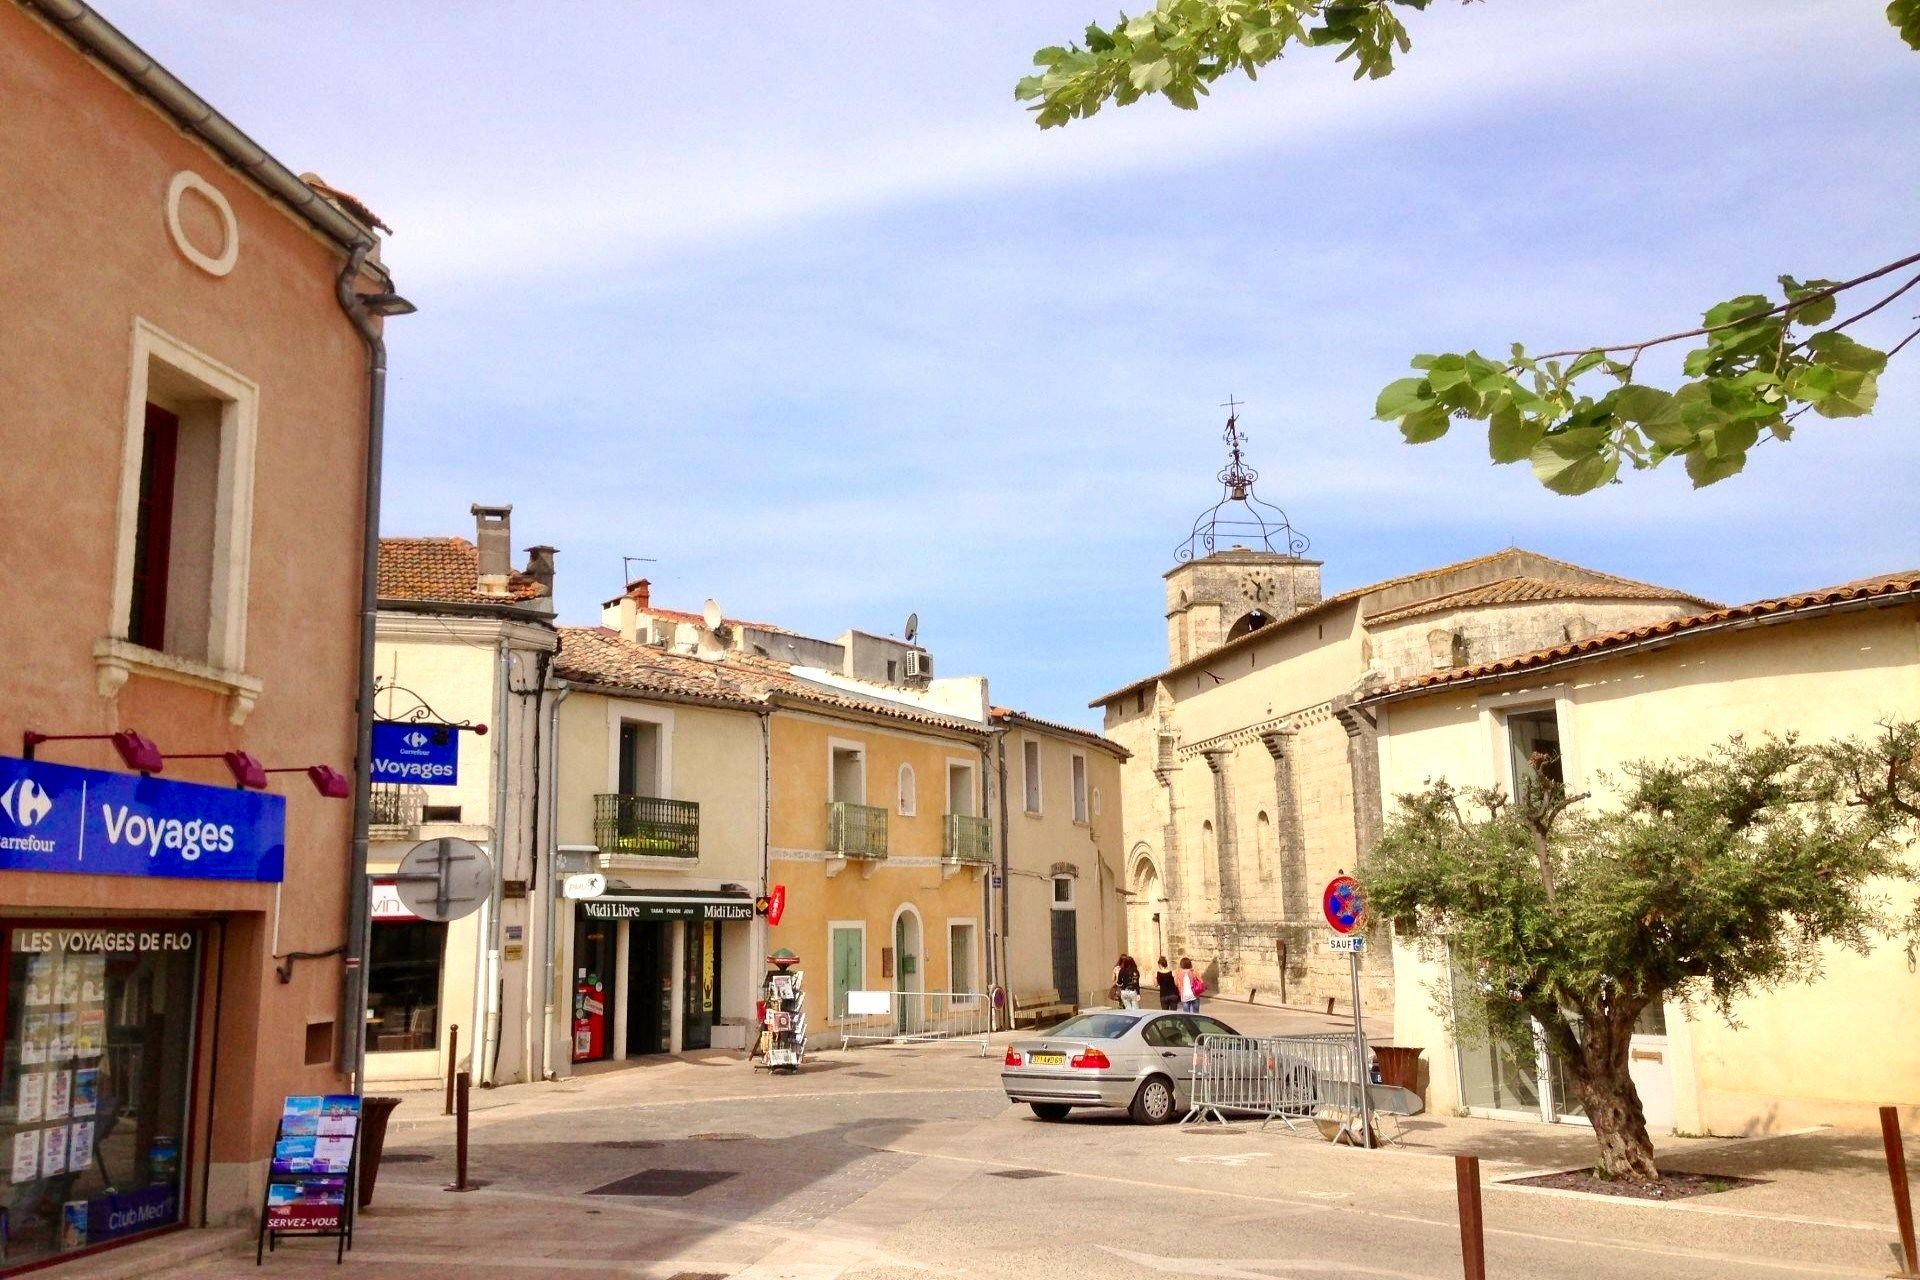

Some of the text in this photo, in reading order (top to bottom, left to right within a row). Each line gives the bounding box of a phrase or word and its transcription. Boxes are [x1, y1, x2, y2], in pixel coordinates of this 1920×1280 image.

[399, 748, 430, 756] Carrefour
[374, 758, 453, 779] Voyages
[102, 803, 235, 861] Voyages
[0, 834, 56, 853] arrefour
[584, 903, 640, 917] Midi Libre
[704, 905, 752, 918] Midi Libre
[20, 932, 192, 952] LES VOYAGES DE FLO
[1330, 940, 1352, 949] SAUF
[267, 1217, 338, 1228] SERVEZ-VOUS
